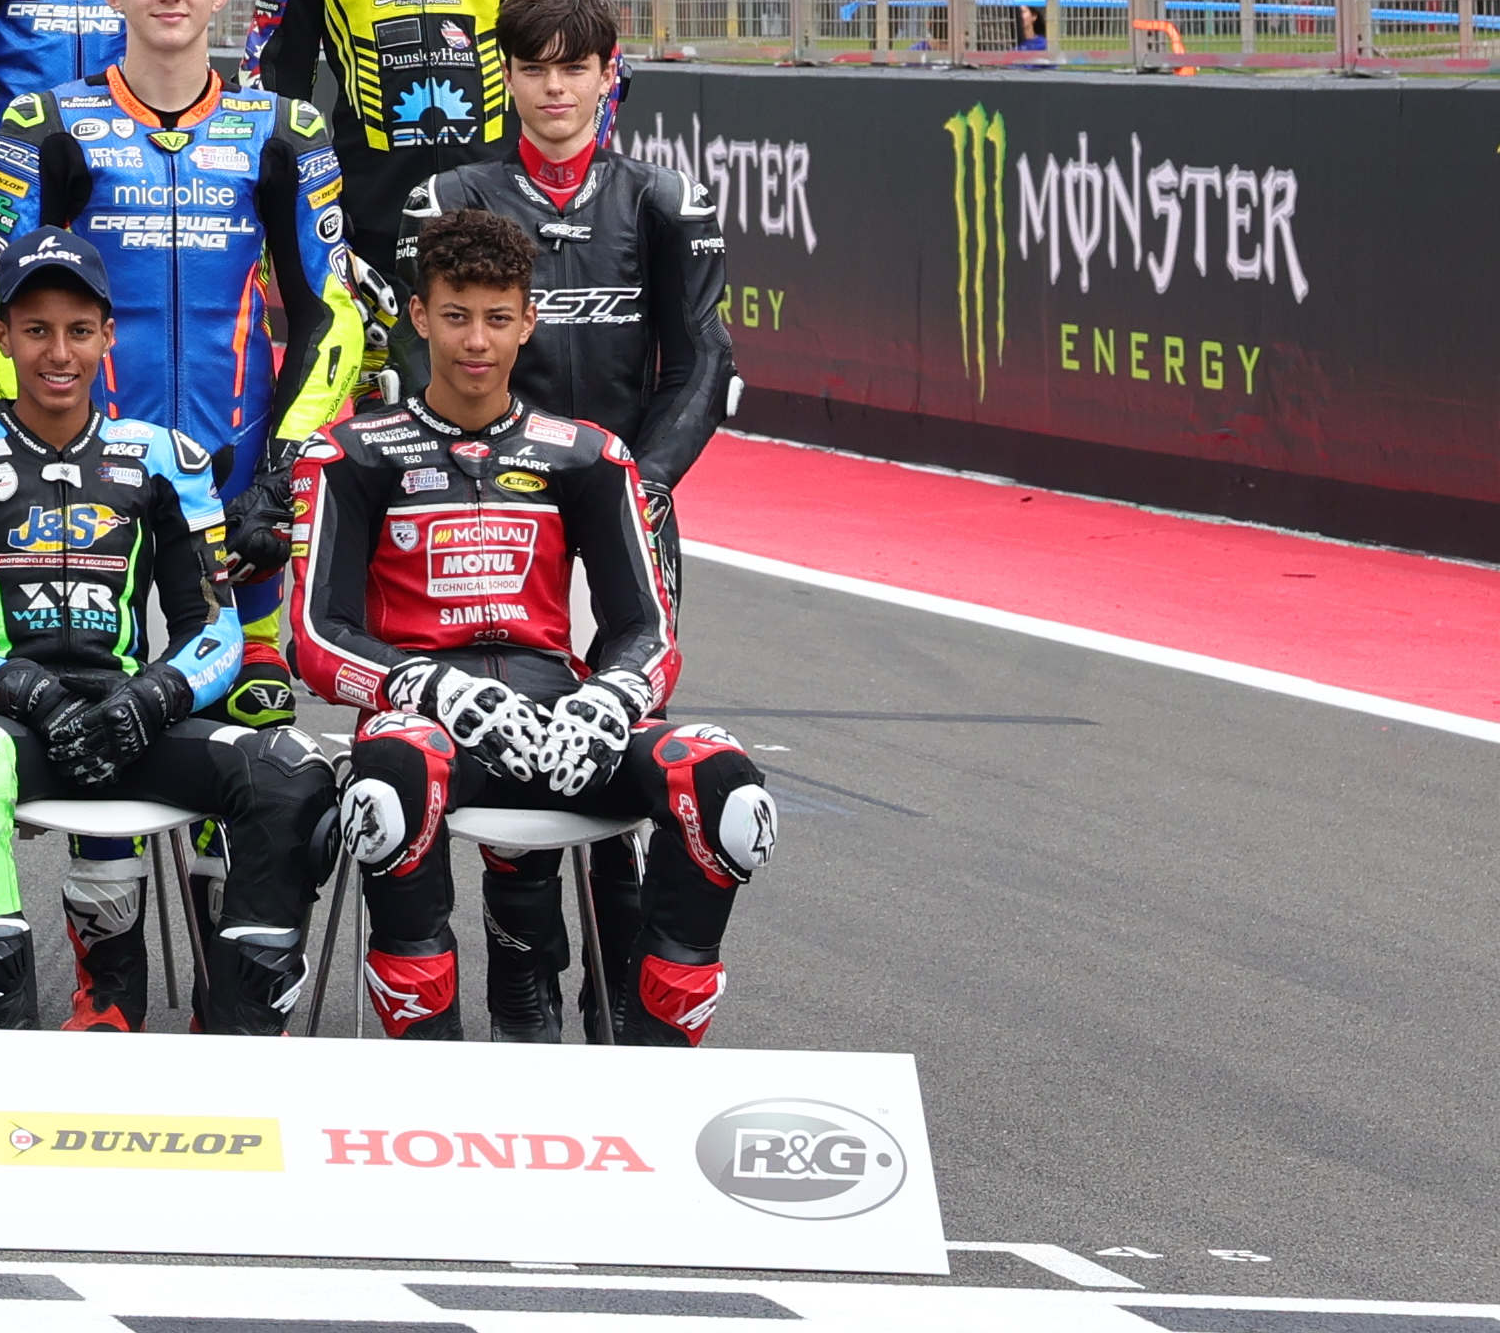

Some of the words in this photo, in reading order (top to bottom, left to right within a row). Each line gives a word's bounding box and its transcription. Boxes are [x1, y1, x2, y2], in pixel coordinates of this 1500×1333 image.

[221, 99, 270, 110] RUBAE
[91, 157, 112, 167] AIR
[117, 157, 143, 168] BAG
[114, 184, 236, 207] microlise
[89, 215, 256, 233] CRESSWELL
[1016, 132, 1309, 304] MONSTER
[122, 233, 229, 249] RACING
[18, 250, 82, 267] SHARK
[1061, 324, 1261, 394] ENERGY
[382, 441, 438, 455] SAMSUNG
[403, 455, 422, 464] SSD
[499, 456, 551, 472] SHARK
[451, 526, 528, 542] MONLAU
[442, 554, 515, 575] MOTUL
[432, 582, 486, 593] TECHNICAL
[488, 580, 519, 590] SCHOOL
[13, 609, 117, 623] WILSON
[439, 604, 528, 626] SAMSUNG
[51, 1129, 264, 1157] DUNLOP
[321, 1129, 656, 1174] HONDA
[732, 1128, 869, 1181] R&G
